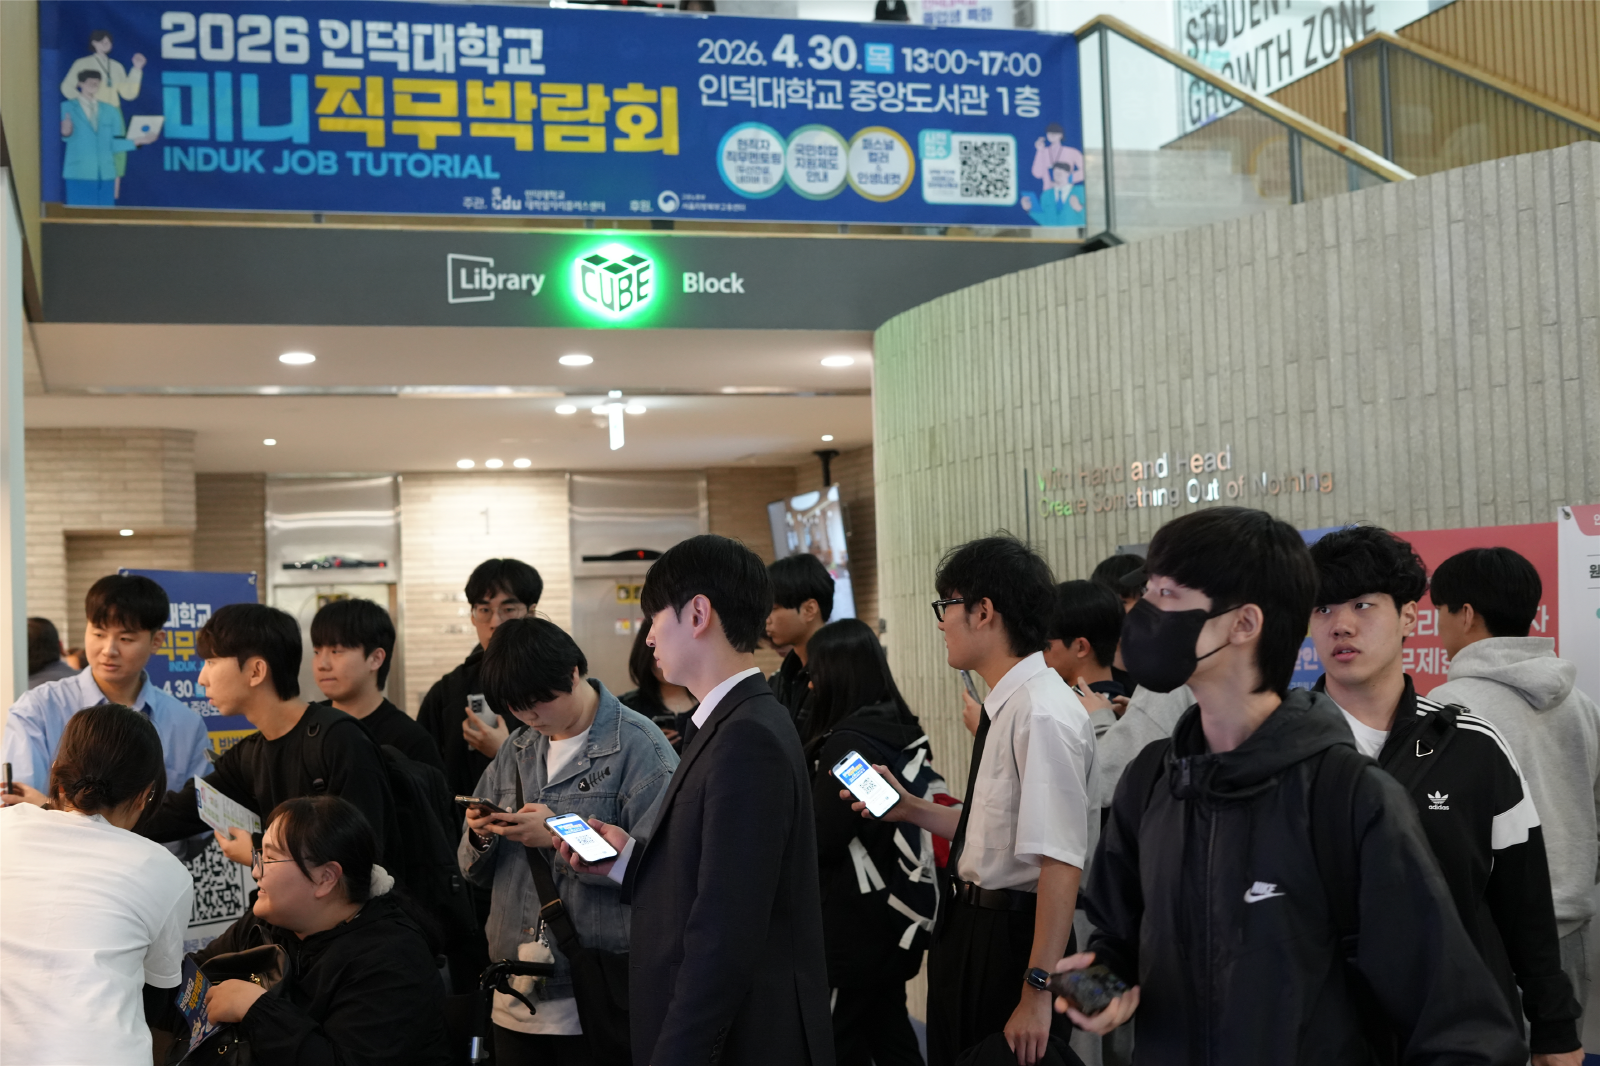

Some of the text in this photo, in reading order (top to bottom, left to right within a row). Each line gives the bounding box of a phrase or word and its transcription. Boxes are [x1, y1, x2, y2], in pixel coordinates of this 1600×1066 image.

[1303, 0, 1377, 69] ZONE
[161, 11, 546, 76] 2026 인덕대학교
[697, 38, 767, 67] 2026.
[771, 34, 803, 68] 4.
[808, 34, 863, 72] 30.
[901, 47, 1042, 77] 13:00~17:00
[699, 74, 844, 110] 인덕대학교
[849, 80, 989, 116] 중앙도서관
[737, 138, 770, 151] 현직자
[795, 144, 838, 157] 국민취업
[862, 138, 894, 151] 퍼스널
[163, 147, 500, 179] INDUK JOB TUTORIAL
[726, 150, 782, 165] 직무멘토링
[794, 157, 838, 170] 지원제도
[868, 151, 889, 164] 컬러
[806, 170, 828, 183] 안내
[857, 172, 901, 186] 인생네컷
[460, 262, 745, 312] Library CUBE Block
[1079, 463, 1124, 486] Hand
[1131, 452, 1168, 481] and
[1176, 444, 1231, 476] Head
[1038, 469, 1333, 518] Create Something Out of Nothing
[168, 661, 197, 672] INDUK
[1251, 881, 1278, 895] NIKE
